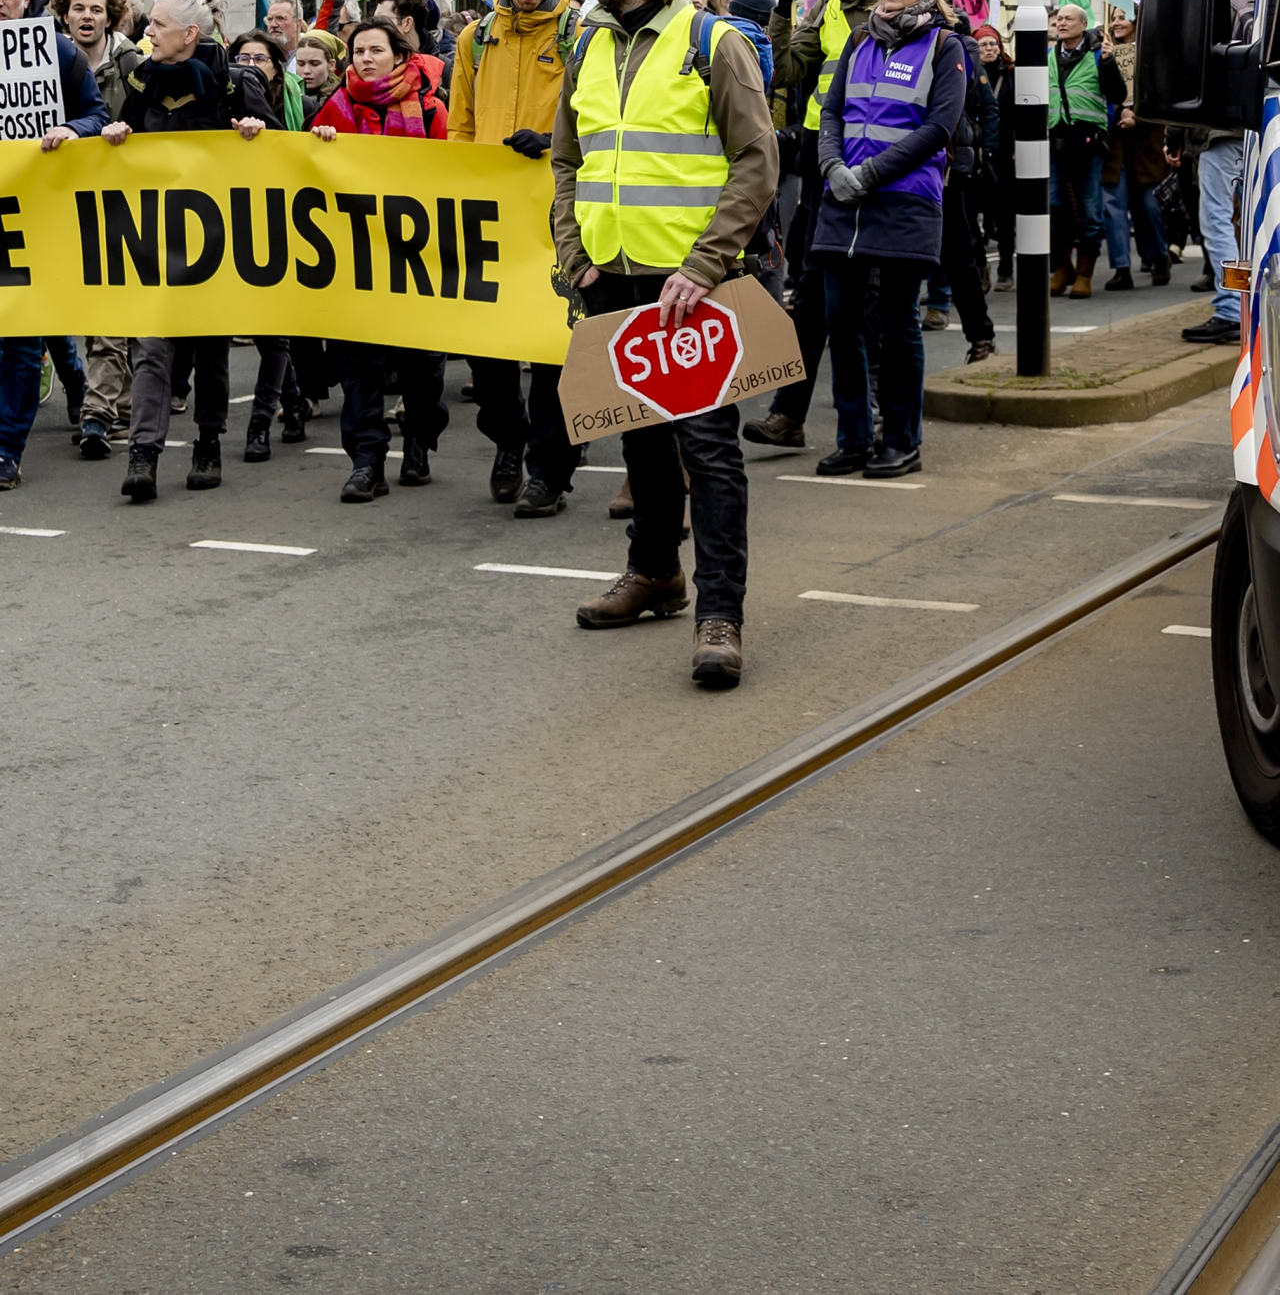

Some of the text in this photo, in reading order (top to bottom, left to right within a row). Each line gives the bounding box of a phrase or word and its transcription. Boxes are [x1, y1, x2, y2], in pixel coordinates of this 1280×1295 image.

[3, 25, 52, 70] PER
[889, 61, 914, 73] POLITIE
[885, 69, 912, 82] LIAISON
[75, 186, 499, 303] INDUSTRIE
[624, 318, 724, 383] STOP
[572, 403, 651, 438] FOSSIELE
